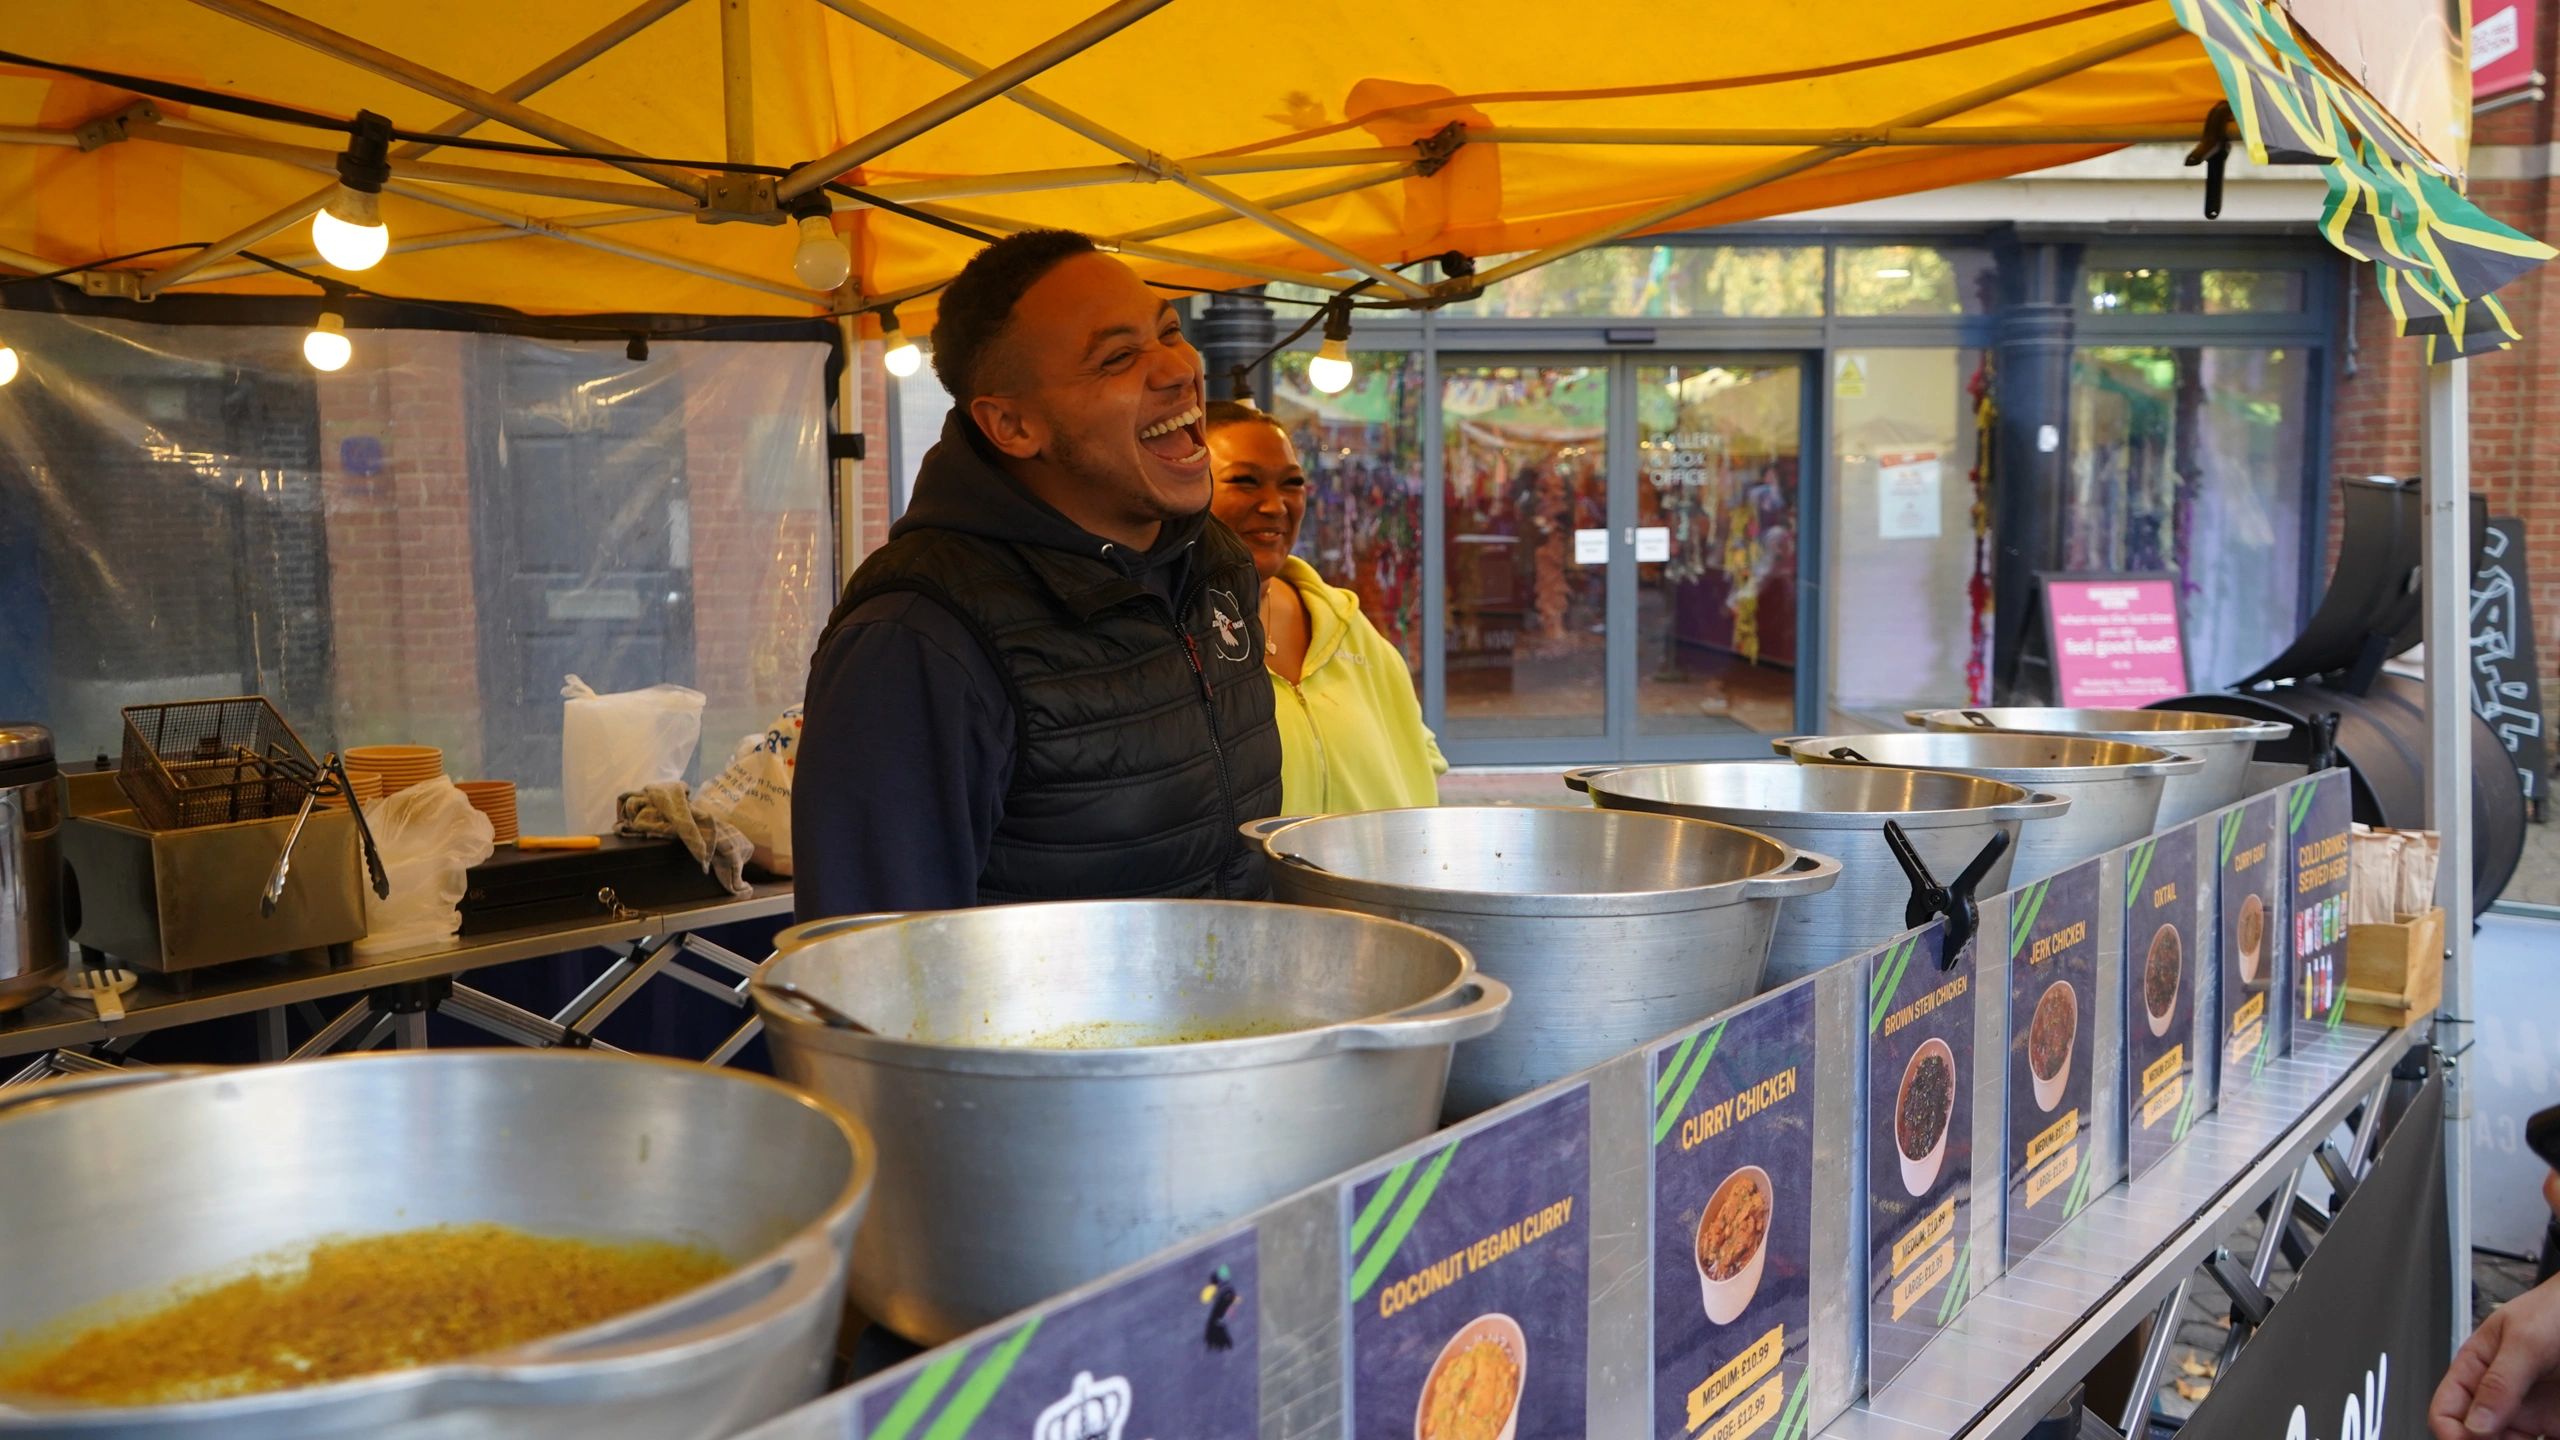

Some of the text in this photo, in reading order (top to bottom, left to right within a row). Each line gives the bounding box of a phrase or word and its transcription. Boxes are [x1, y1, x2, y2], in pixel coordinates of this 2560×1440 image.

[1650, 432, 1724, 449] GALLERY
[1670, 451, 1705, 468] BOX
[1649, 469, 1708, 487] OFFICE
[2064, 636, 2177, 658] feel good food?
[2234, 842, 2266, 873] CURRY GOAT
[2299, 832, 2348, 868] COLD DRINKS
[2299, 856, 2347, 893] SERVED HERE
[2154, 882, 2176, 909] OXTAIL
[2030, 919, 2086, 965] JERK CHICKEN
[1884, 974, 1968, 1037] BROWN STEW CHICKEN
[1682, 1066, 1796, 1150] CURRY CHICKEN
[1380, 1196, 1573, 1318] COCONUT VEGAN CURRY
[1702, 1343, 1769, 1408] MEDIUM: £10.99
[1710, 1394, 1765, 1440] ARGE: £12.99
